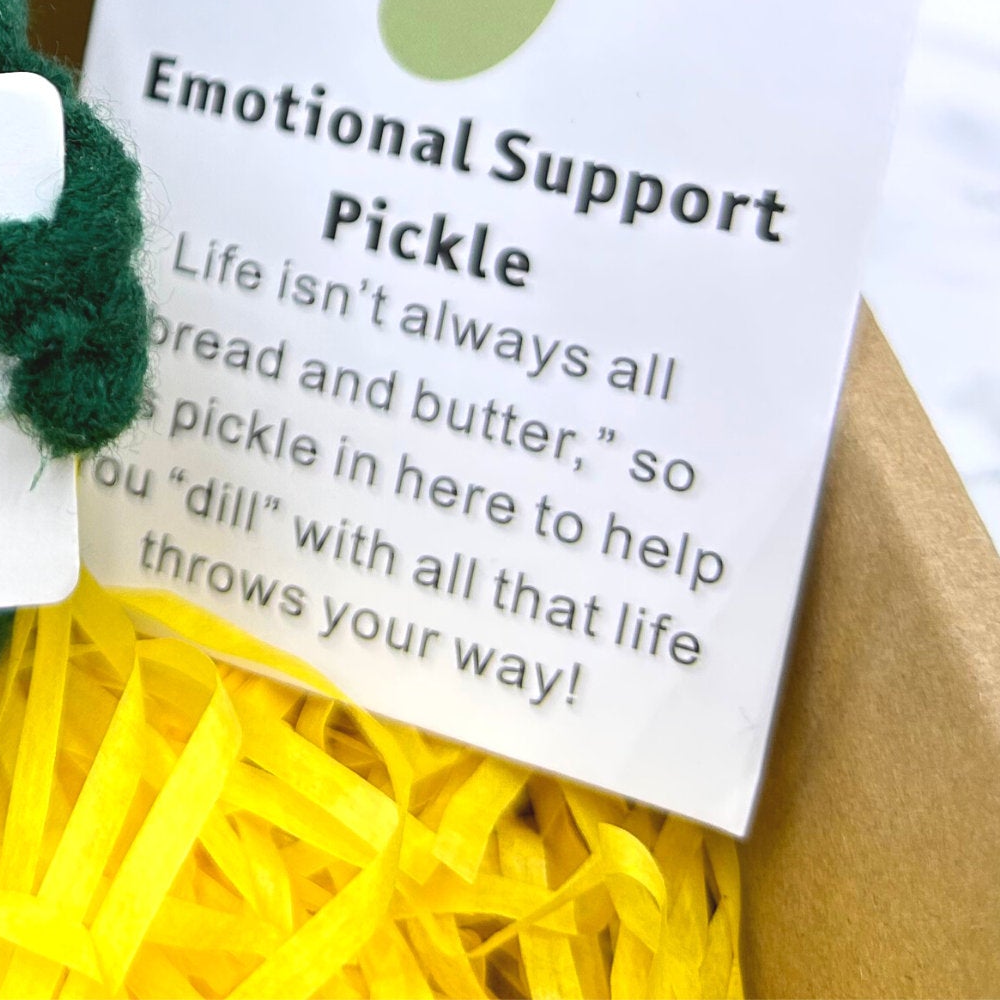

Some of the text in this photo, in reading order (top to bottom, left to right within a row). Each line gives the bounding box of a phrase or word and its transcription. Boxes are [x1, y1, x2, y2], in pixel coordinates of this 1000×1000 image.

[144, 54, 786, 242] Emotional Support
[171, 230, 263, 290] Life
[400, 299, 590, 379] always
[606, 350, 678, 400] all
[322, 190, 532, 289] Pickle
[169, 396, 318, 467] pickle
[334, 435, 378, 486] in
[394, 452, 517, 525] here
[534, 493, 584, 547] to
[600, 509, 726, 594] help
[300, 352, 398, 413] and
[630, 447, 696, 493] so
[76, 452, 152, 500] ou
[293, 508, 396, 577] with
[411, 545, 477, 600] all
[493, 565, 602, 638] that
[614, 600, 703, 668] life
[139, 529, 583, 706] throws your way!
